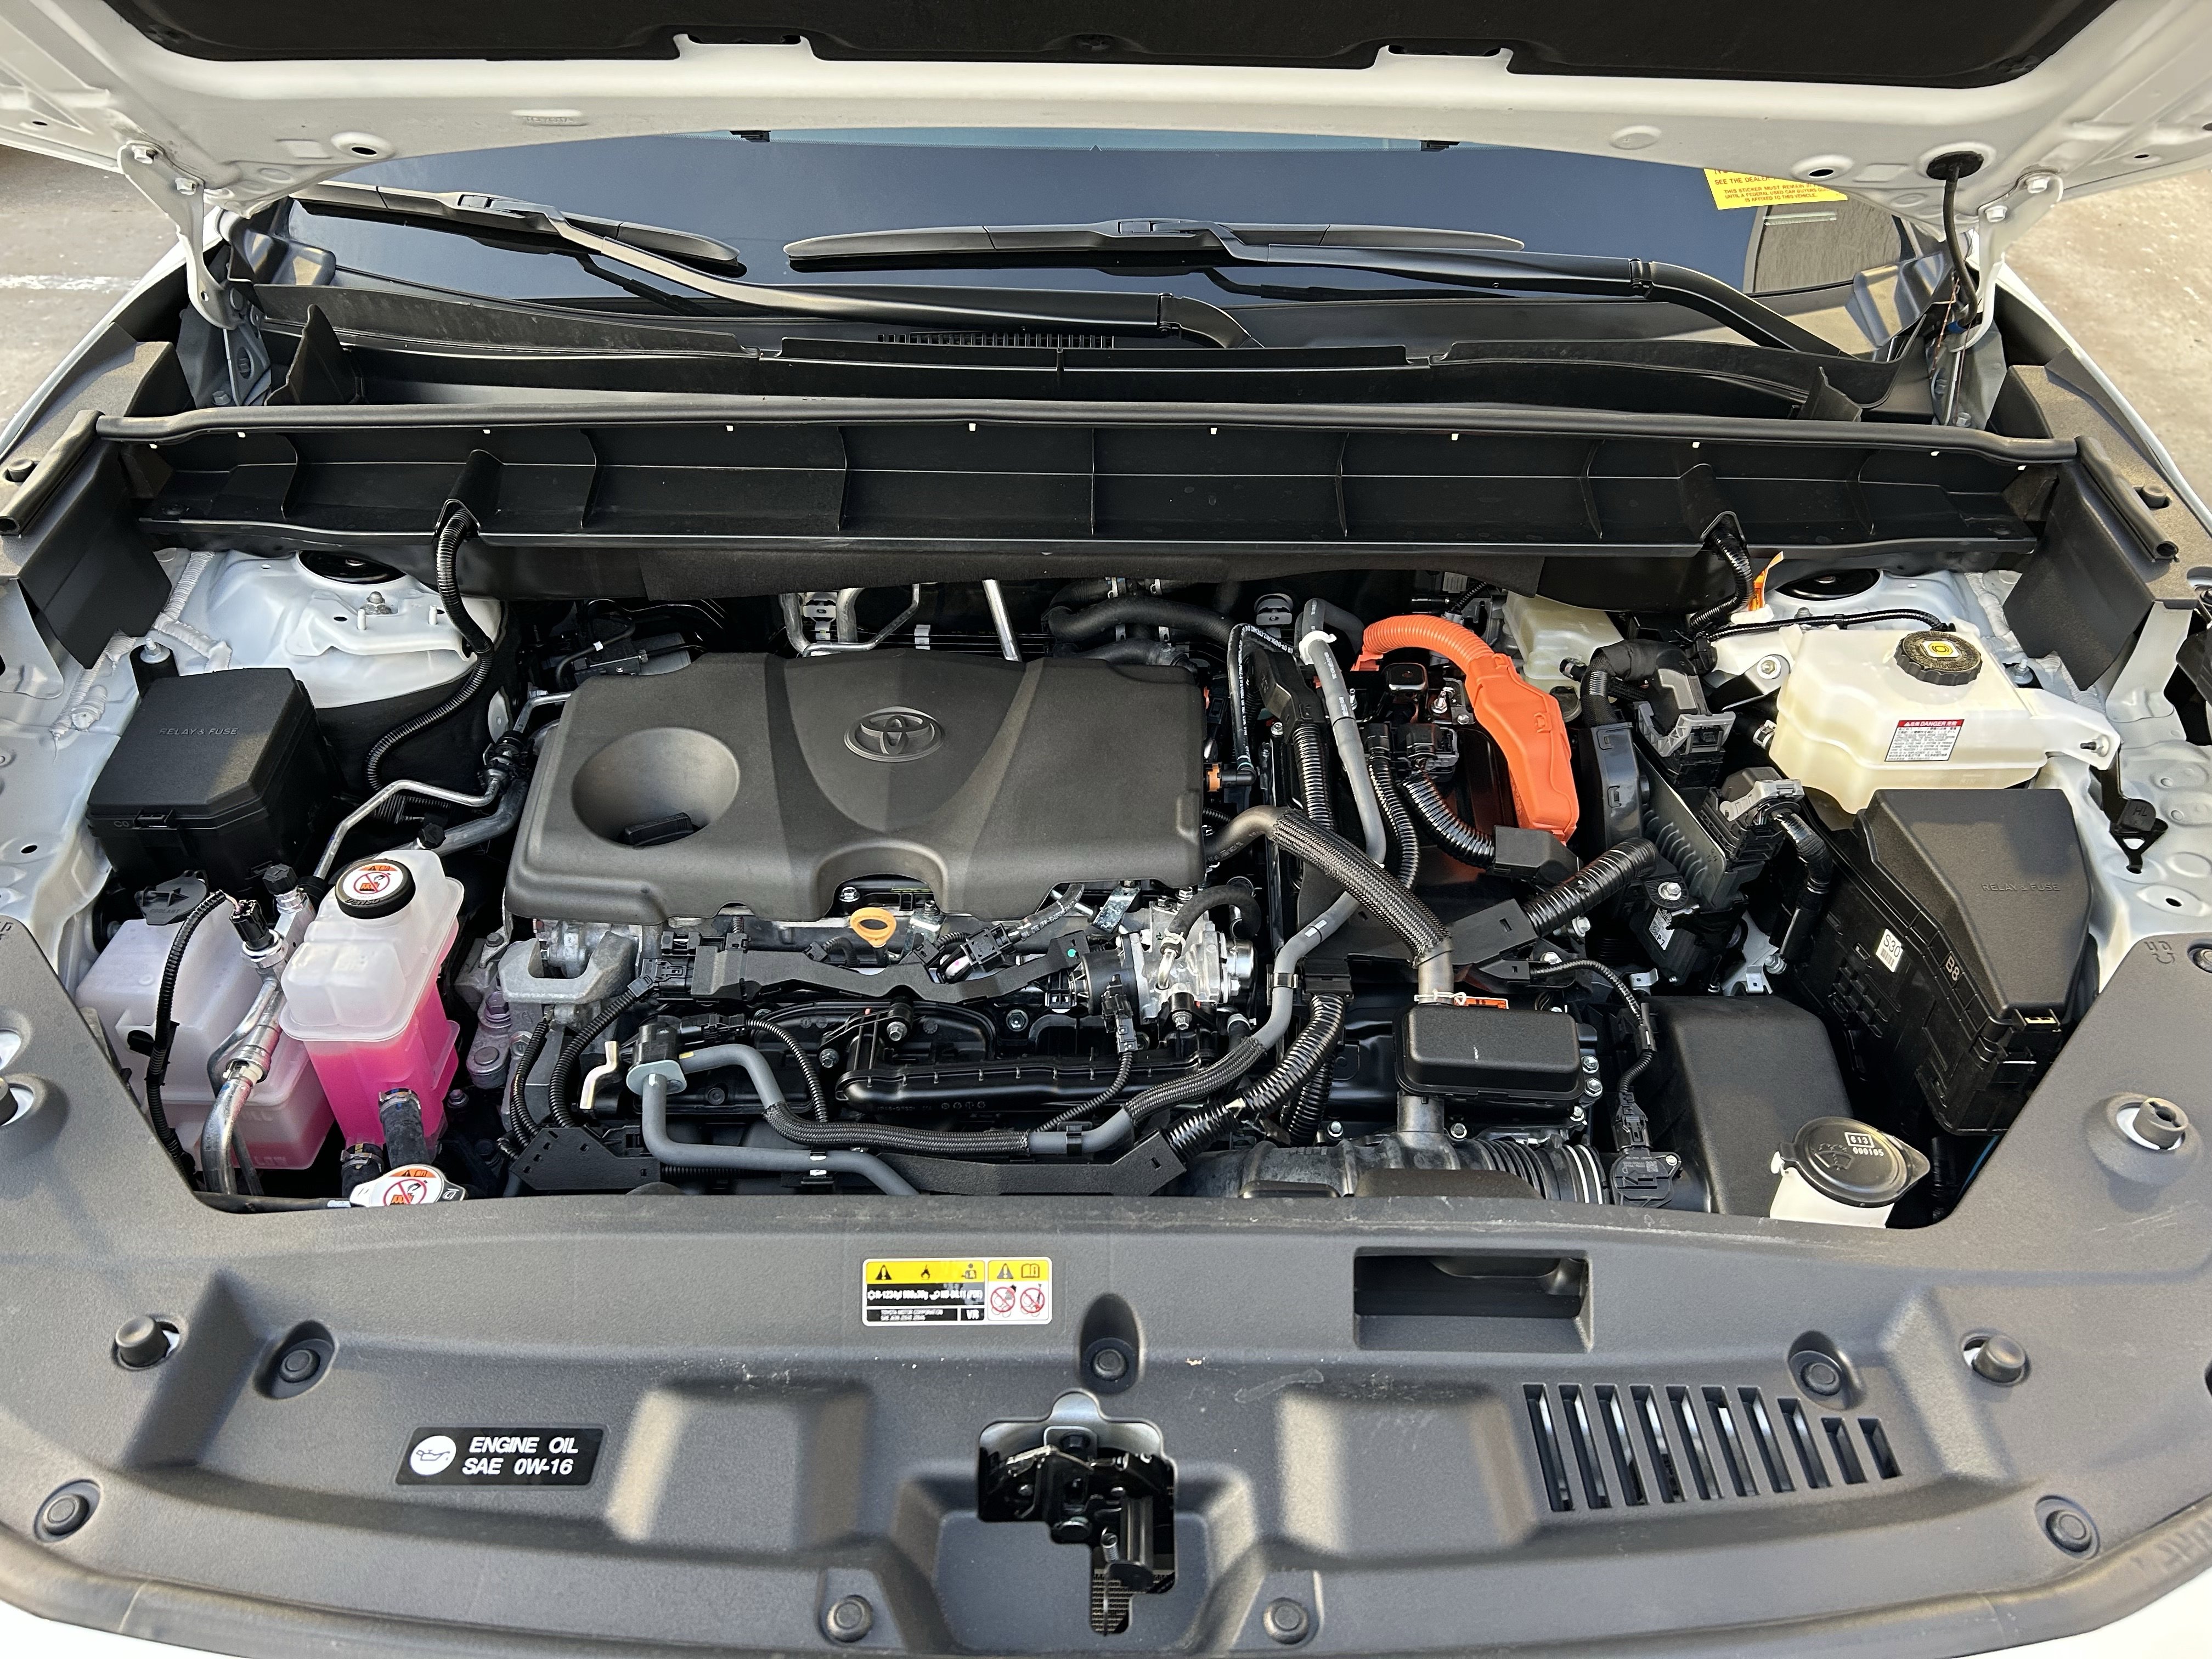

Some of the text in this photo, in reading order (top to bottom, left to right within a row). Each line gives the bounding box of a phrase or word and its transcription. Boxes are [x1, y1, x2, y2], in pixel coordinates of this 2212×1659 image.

[1981, 883, 2018, 891] RELAY
[2029, 883, 2061, 891] FUSE
[1883, 934, 1901, 958] S30
[1945, 955, 1960, 981] B8
[1850, 1135, 1869, 1145] e13
[1853, 1147, 1884, 1156] 000105
[469, 1436, 579, 1454] ENGINE OIL
[462, 1457, 573, 1475] SAE 0W-16
